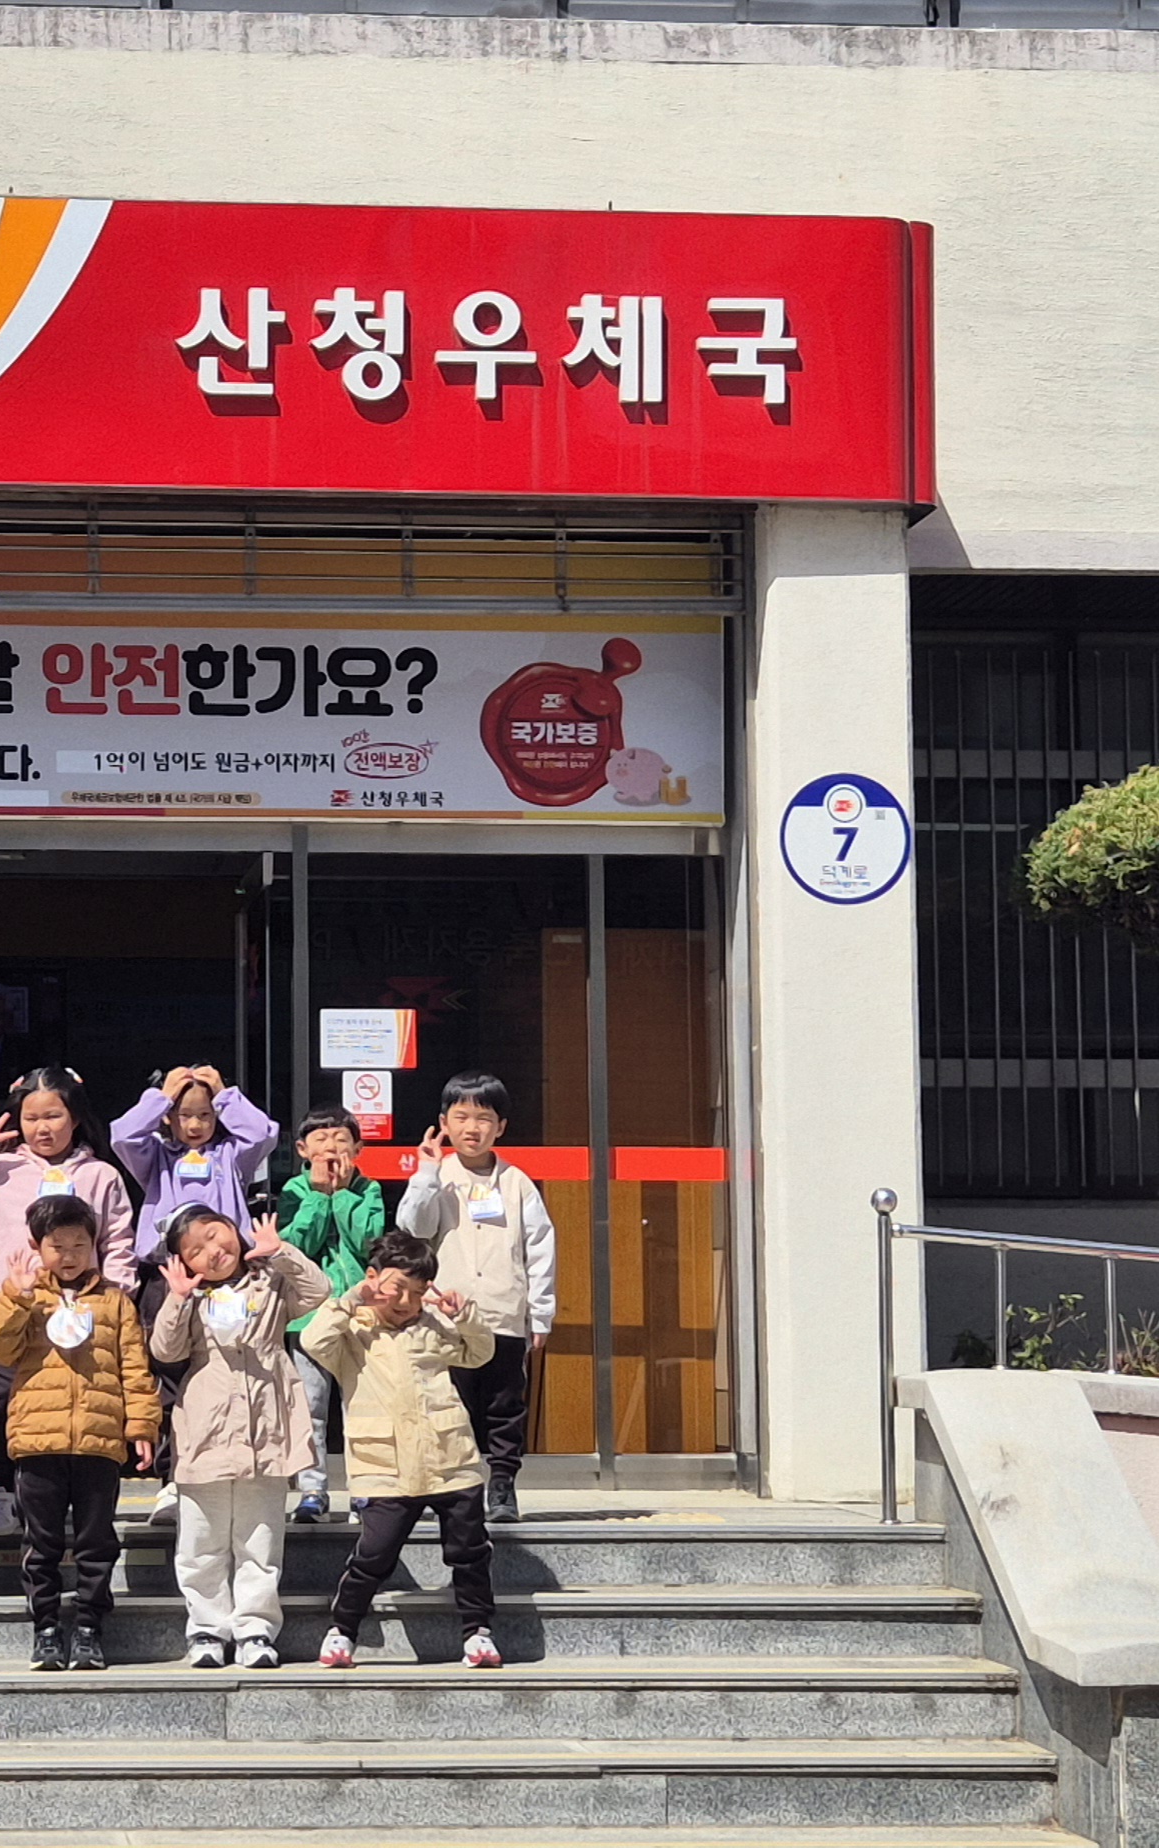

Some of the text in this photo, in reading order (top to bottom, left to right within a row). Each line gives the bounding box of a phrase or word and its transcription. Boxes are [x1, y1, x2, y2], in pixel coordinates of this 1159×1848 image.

[175, 286, 799, 406] 산청우체국
[41, 641, 439, 718] 안전한가요?
[510, 721, 599, 746] 국가보증
[94, 750, 146, 773] 1억이
[153, 751, 207, 773] 넘어도
[215, 751, 335, 774] 원금+이자까지
[353, 751, 421, 772] 전액보장
[360, 790, 446, 808] 산청우체국
[832, 826, 859, 862] 7
